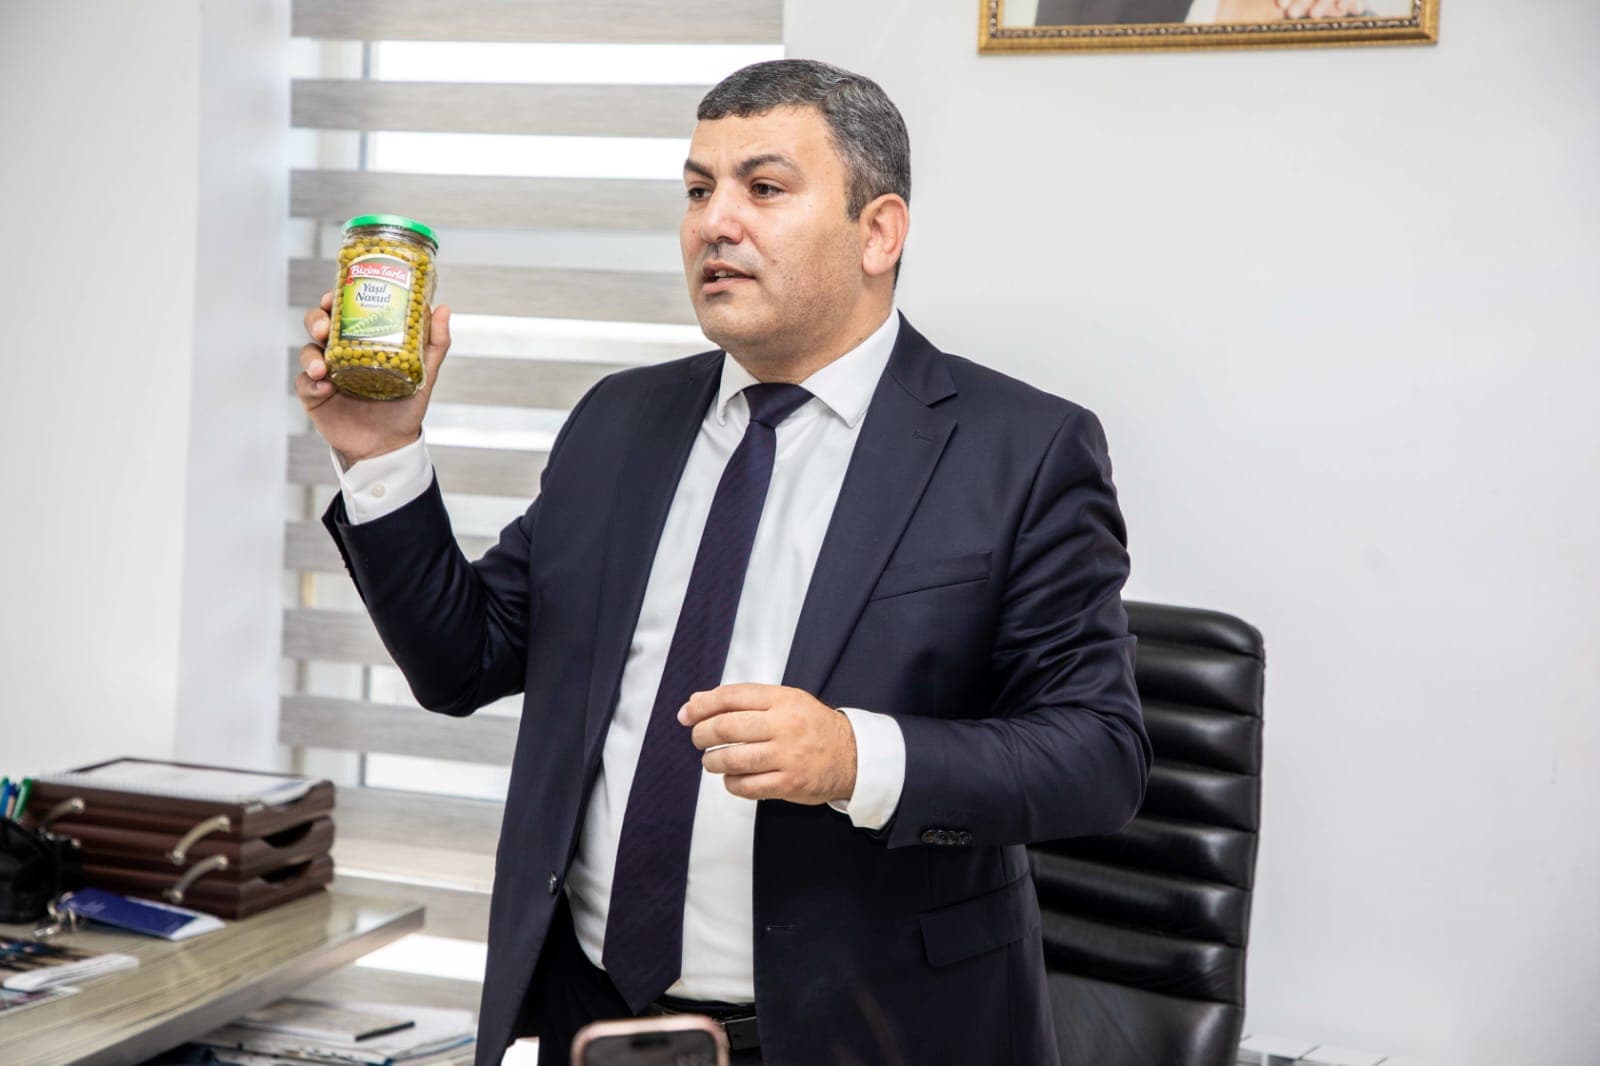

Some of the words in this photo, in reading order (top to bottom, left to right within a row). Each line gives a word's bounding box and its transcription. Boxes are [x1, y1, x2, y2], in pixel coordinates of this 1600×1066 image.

[351, 265, 380, 276] Bizim
[382, 265, 407, 280] Tarla
[355, 291, 391, 303] Noxud
